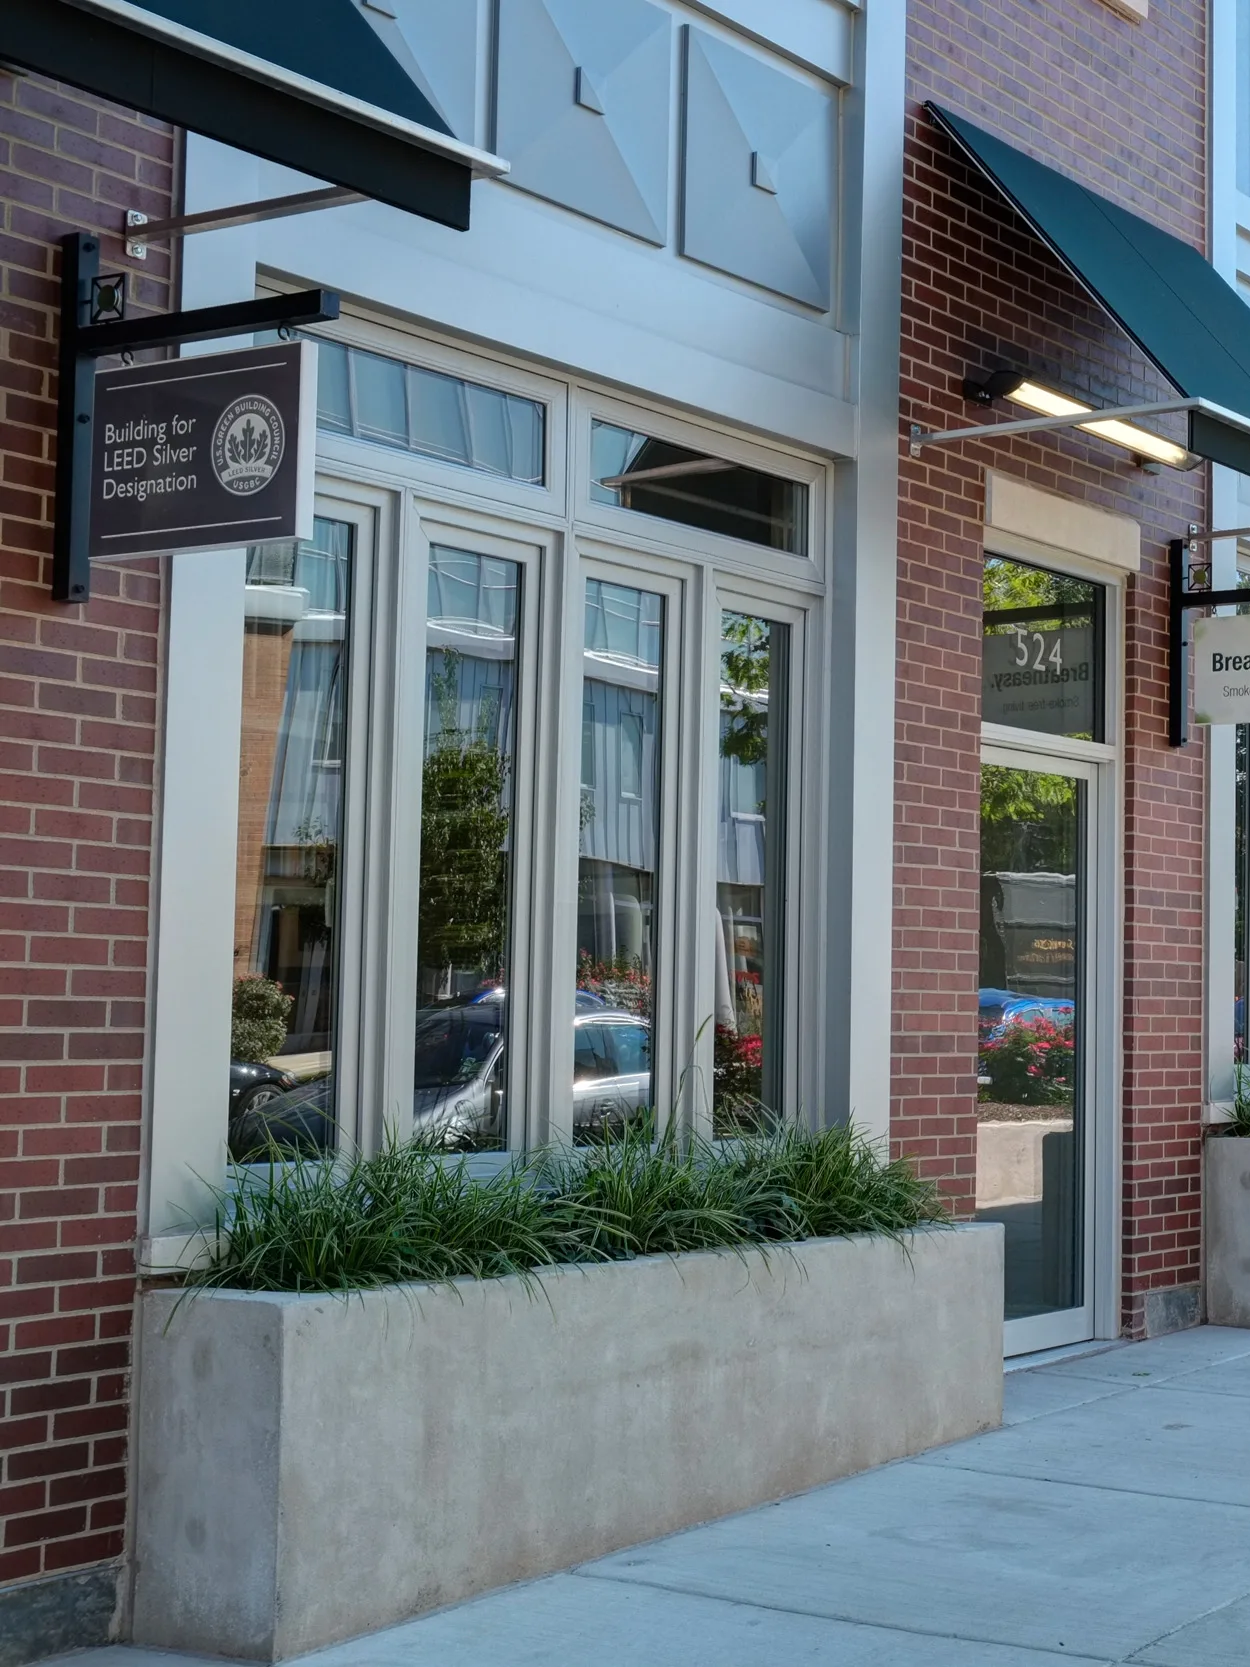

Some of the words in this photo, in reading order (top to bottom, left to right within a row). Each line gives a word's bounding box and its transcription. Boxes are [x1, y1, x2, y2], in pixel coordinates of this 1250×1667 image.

[105, 419, 167, 443] Building
[172, 414, 196, 435] for
[216, 412, 234, 446] GREEN
[235, 401, 271, 417] BUILDING
[270, 415, 280, 460] COUNCIL
[104, 447, 147, 472] LEED
[152, 443, 197, 466] Silver
[103, 472, 197, 501] Designation
[228, 468, 243, 477] LEED
[233, 477, 260, 490] USGBC
[1016, 628, 1062, 675] 524
